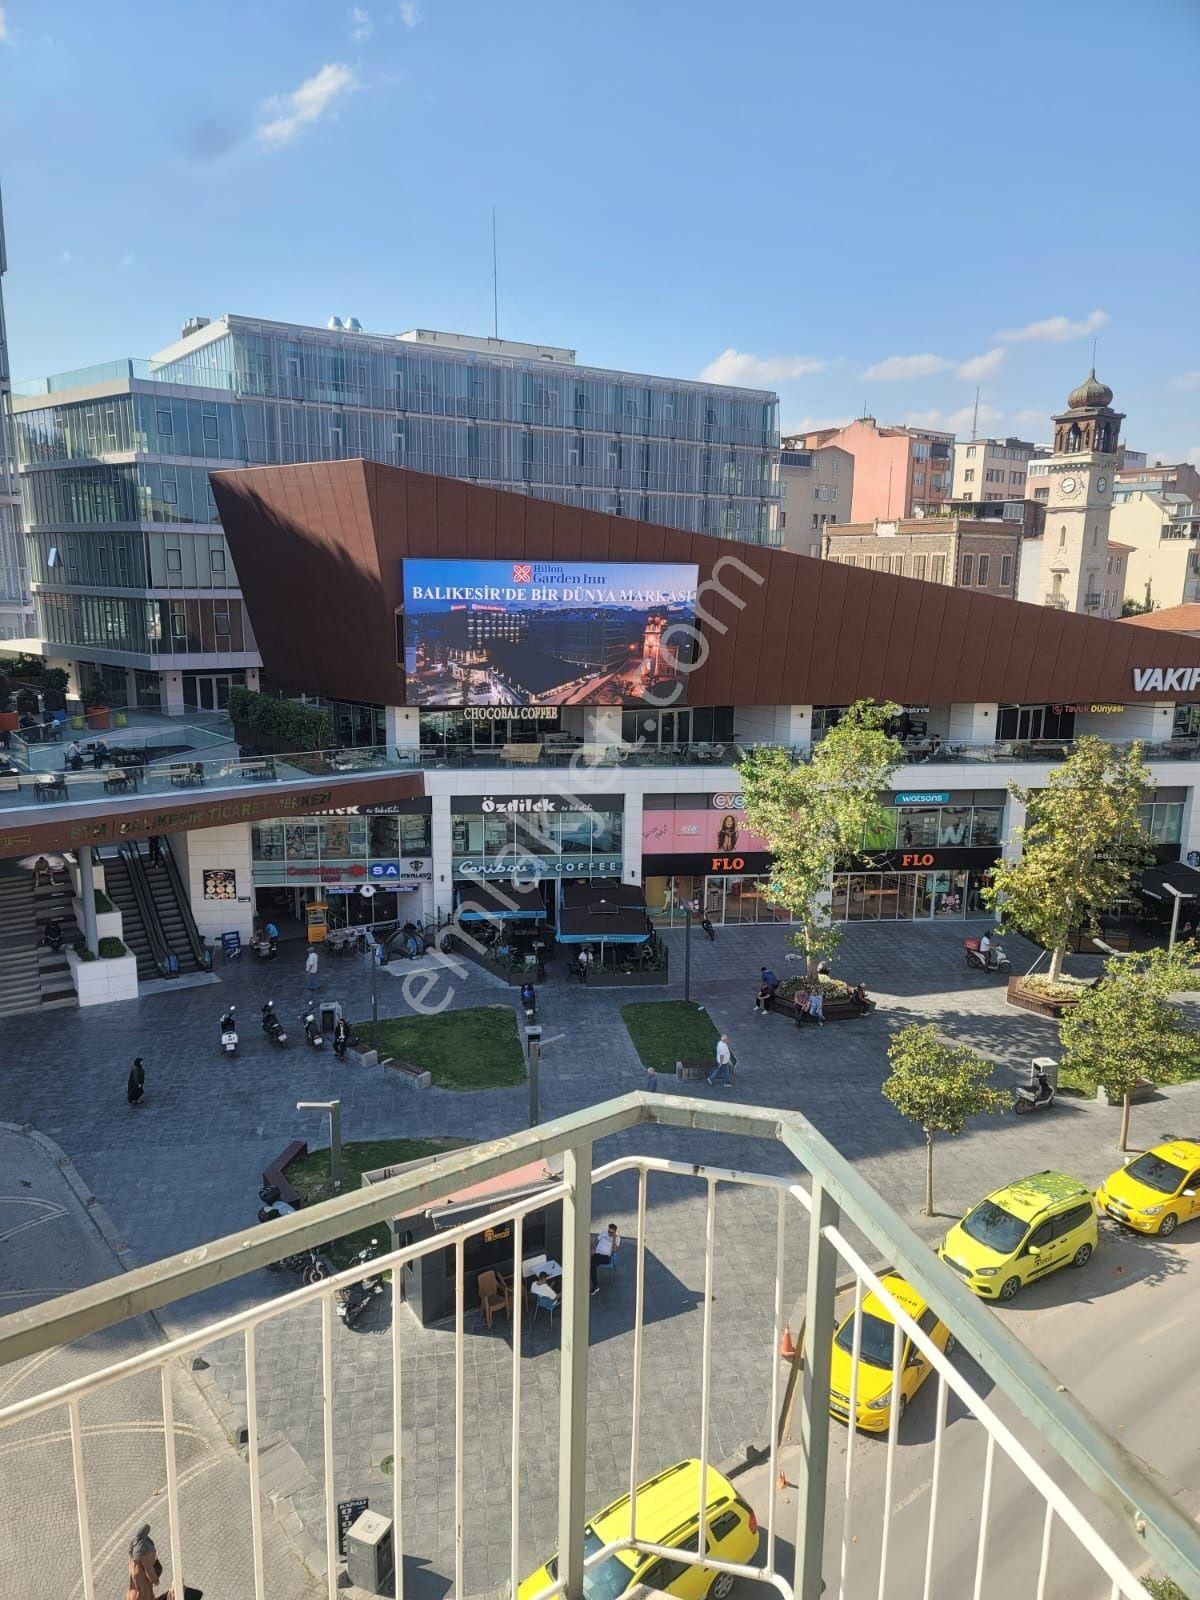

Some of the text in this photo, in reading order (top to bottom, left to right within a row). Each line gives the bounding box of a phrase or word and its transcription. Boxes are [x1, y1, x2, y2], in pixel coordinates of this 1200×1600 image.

[533, 564, 563, 573] Hilton
[533, 574, 606, 584] Garden Inn
[412, 585, 526, 600] BALIKESİR'DE
[531, 586, 559, 601] BİR
[563, 587, 617, 602] DÜNYA
[1064, 703, 1124, 715] Tavuk Dünyası
[902, 794, 943, 802] watsons
[481, 797, 556, 813] Özdilek
[458, 860, 617, 874] Caribou COFFEE
[711, 857, 745, 871] FLO
[902, 854, 934, 867] FLO
